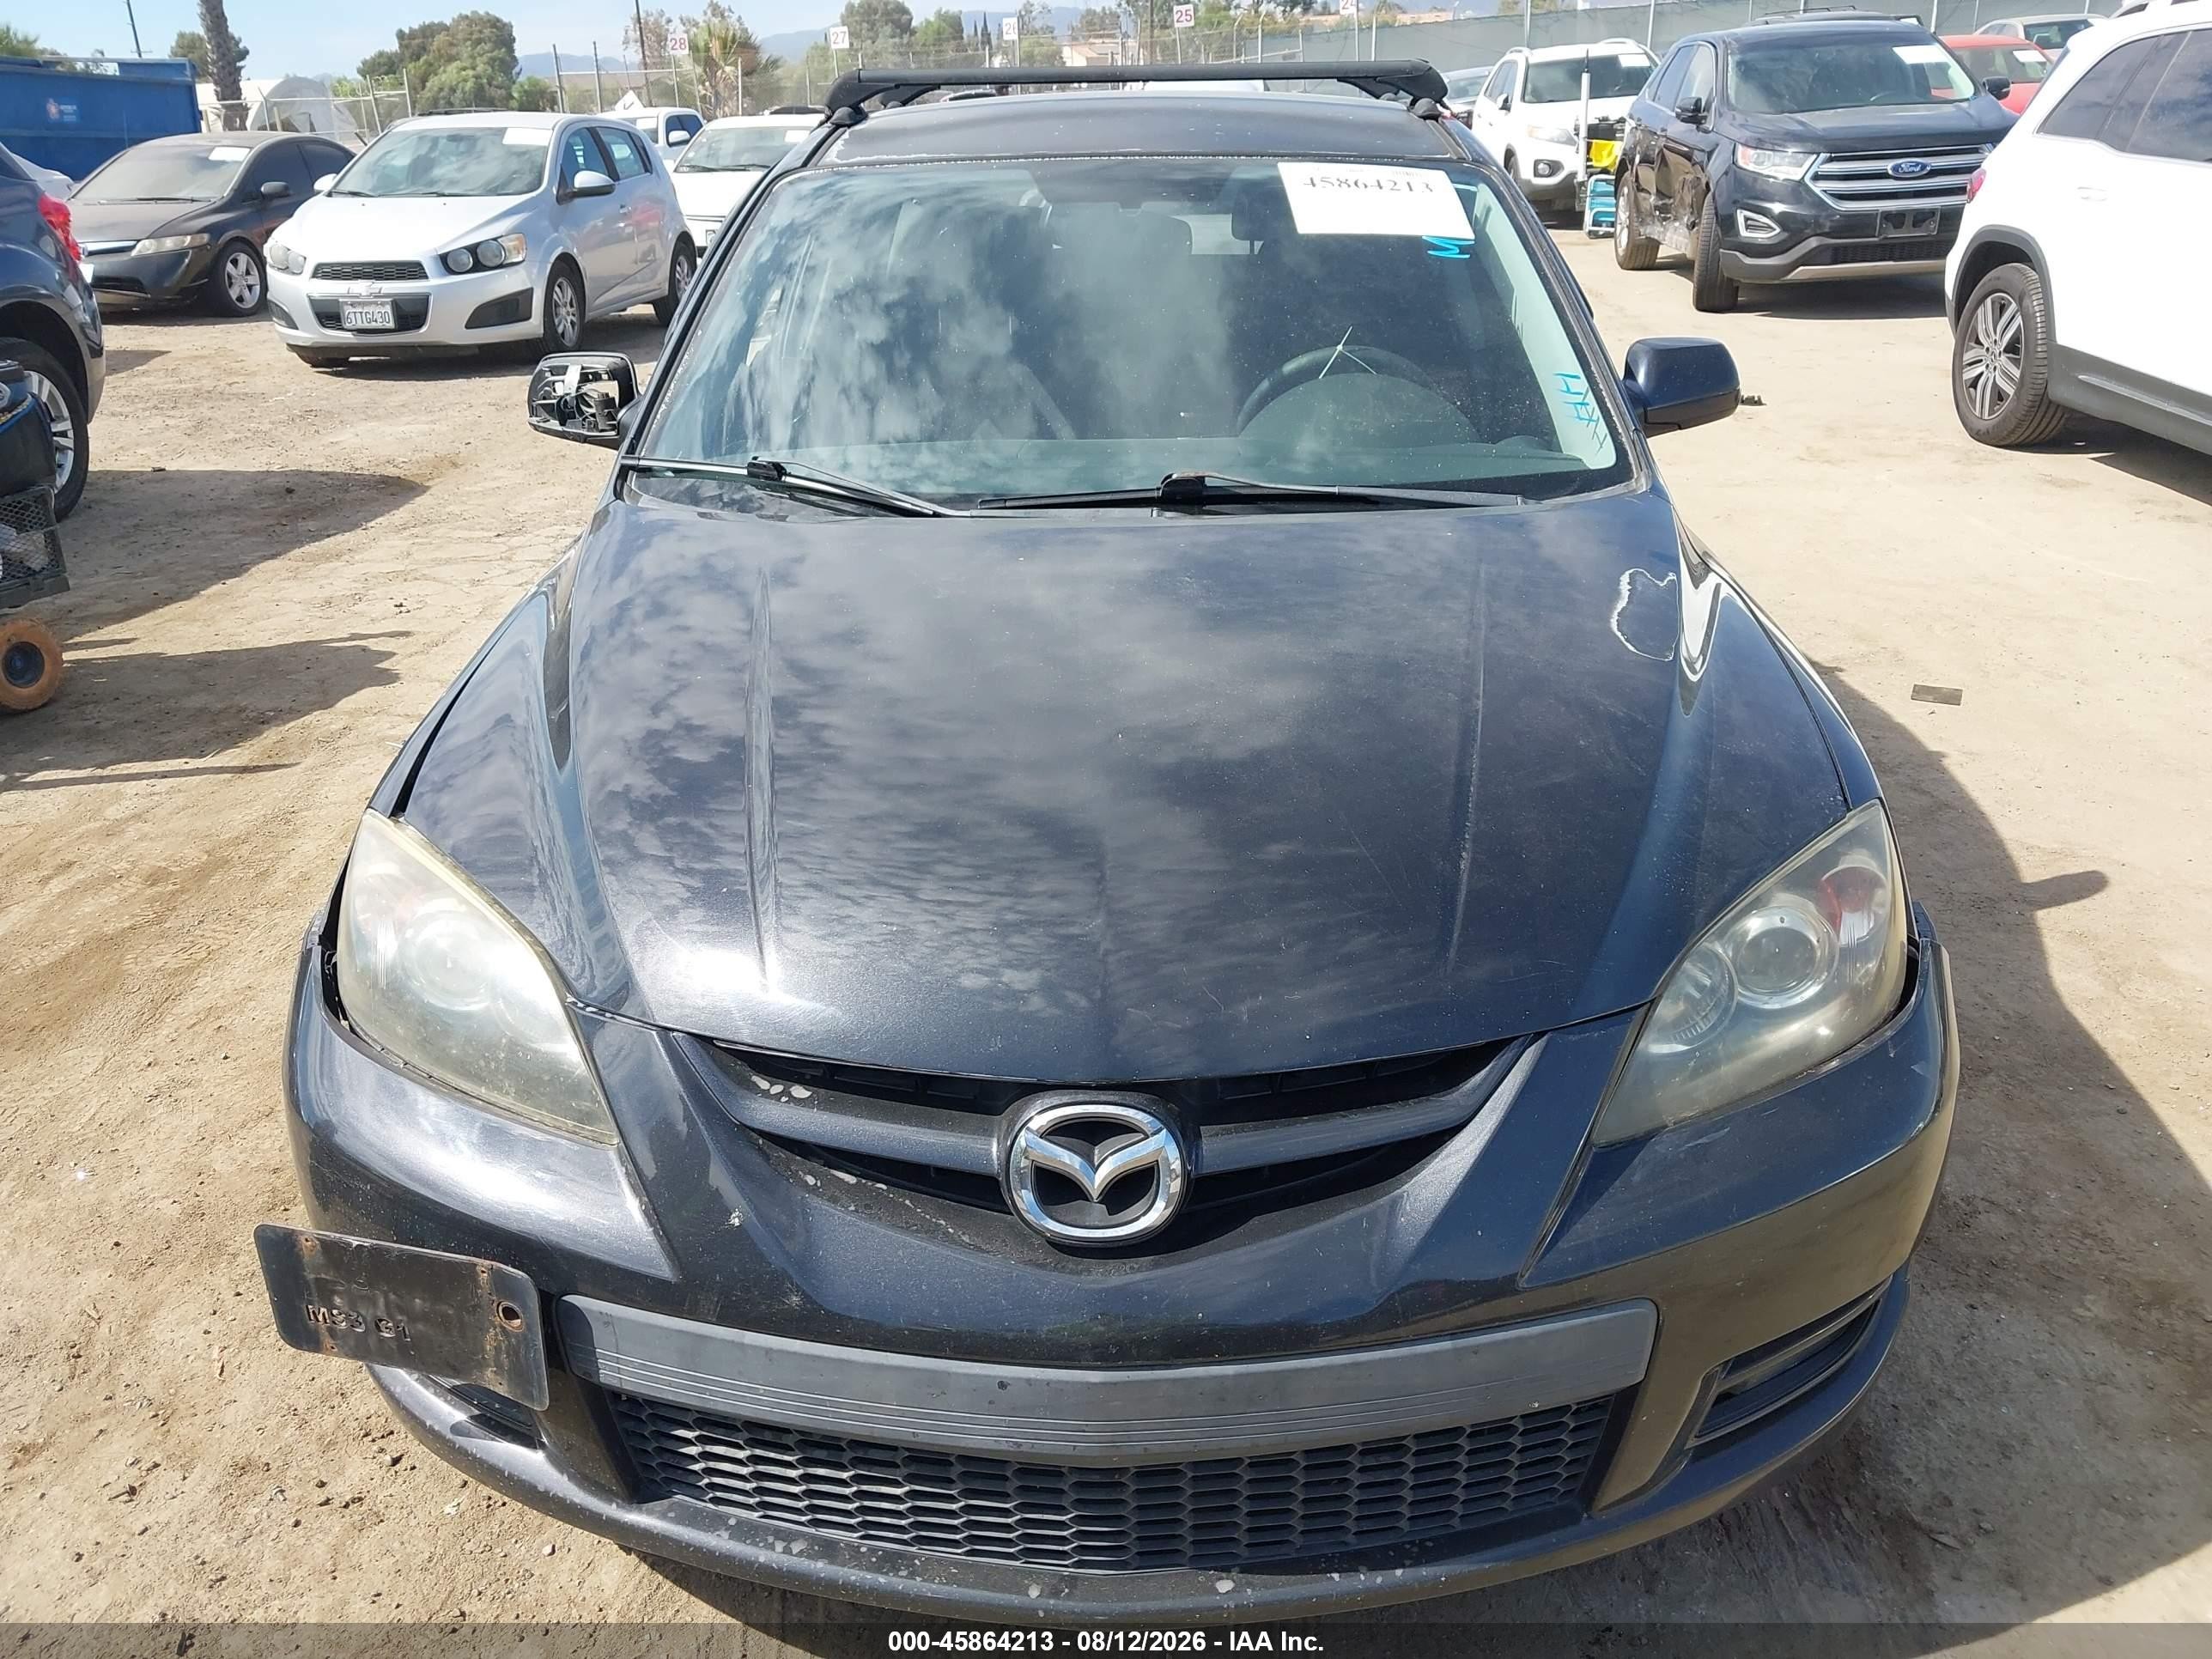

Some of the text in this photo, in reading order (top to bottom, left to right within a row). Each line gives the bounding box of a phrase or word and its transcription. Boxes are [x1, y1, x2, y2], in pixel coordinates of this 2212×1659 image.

[1175, 9, 1193, 22] 25
[670, 37, 687, 50] 28
[832, 30, 847, 44] 27
[345, 310, 392, 325] 6TTG430
[306, 1304, 367, 1333] MS3
